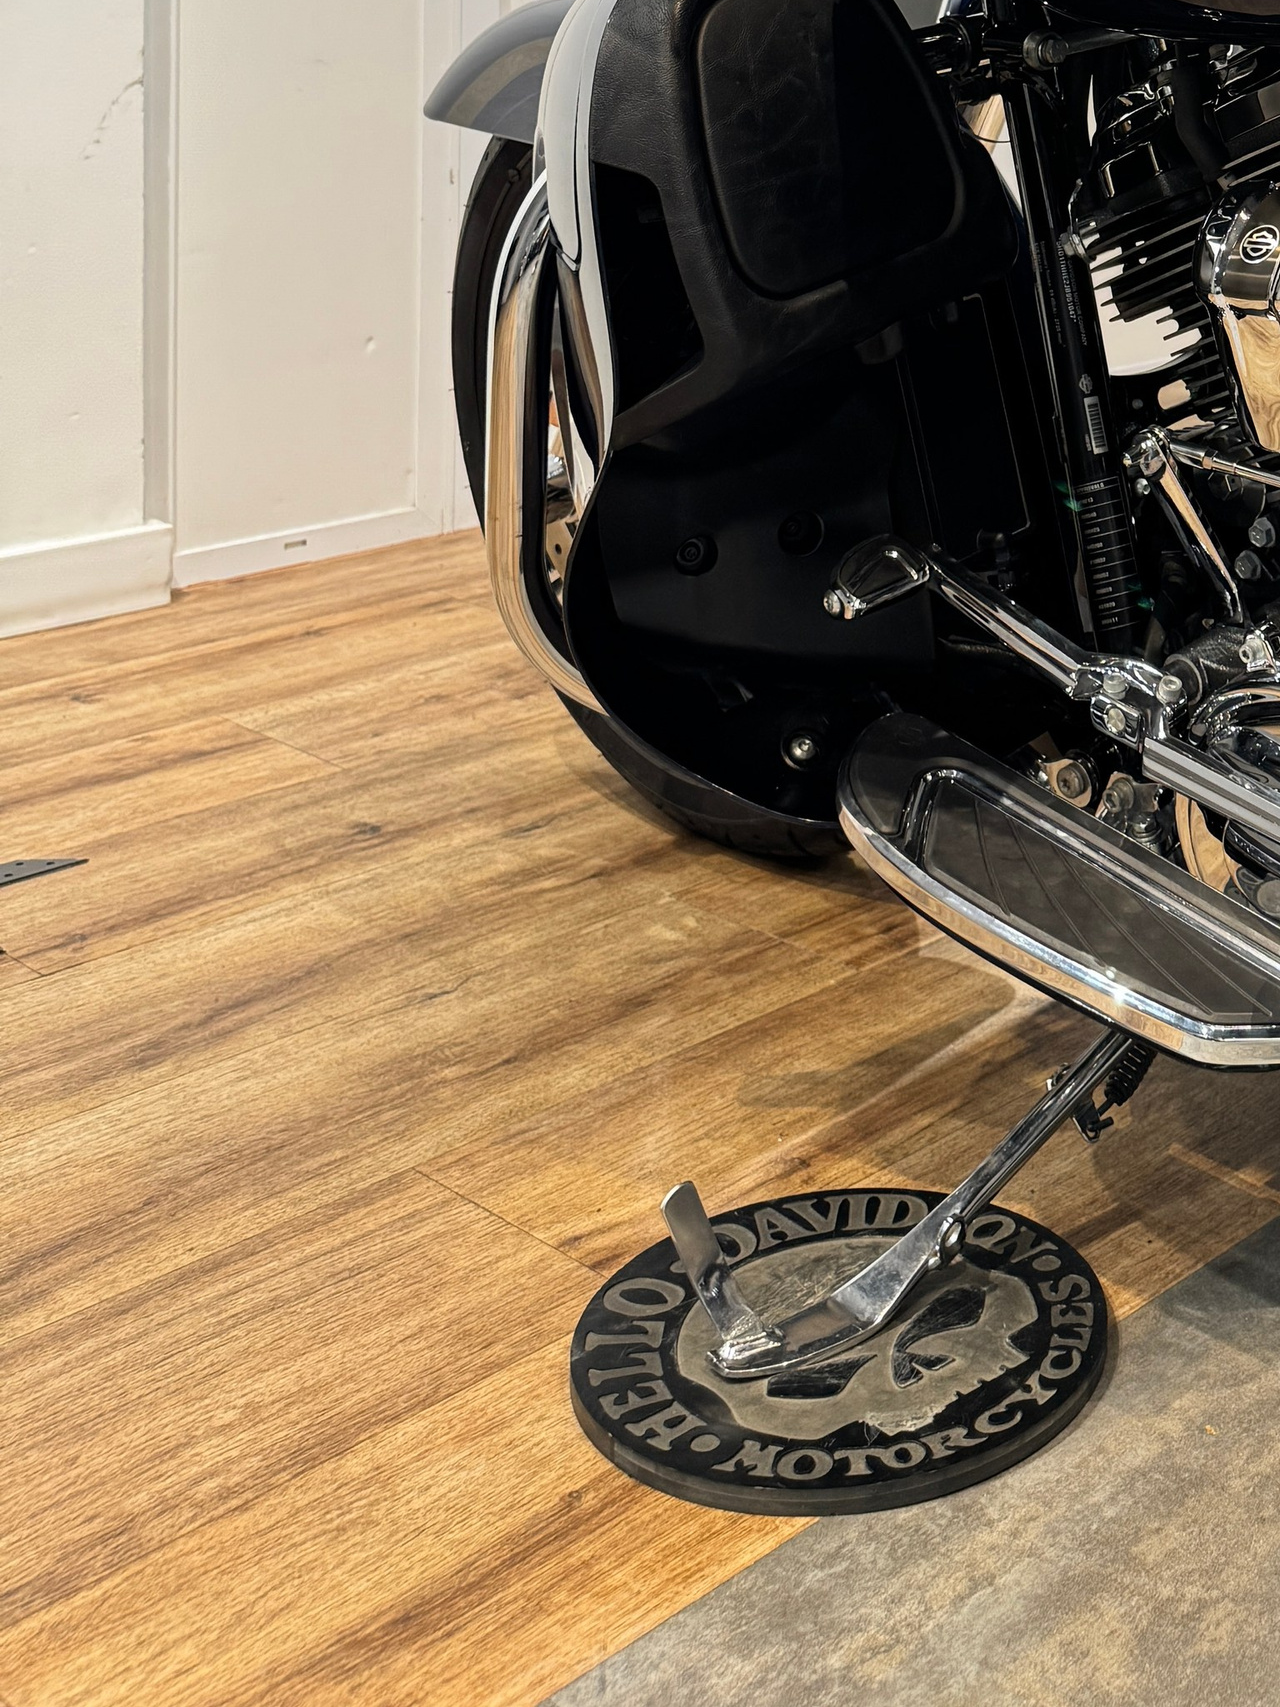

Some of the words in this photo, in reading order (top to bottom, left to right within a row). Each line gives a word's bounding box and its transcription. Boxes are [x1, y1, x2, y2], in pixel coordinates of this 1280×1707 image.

[669, 1194, 1053, 1277] DAVIDON
[585, 1277, 707, 1451] HELLO
[711, 1273, 1093, 1479] MOTORCYCLES
